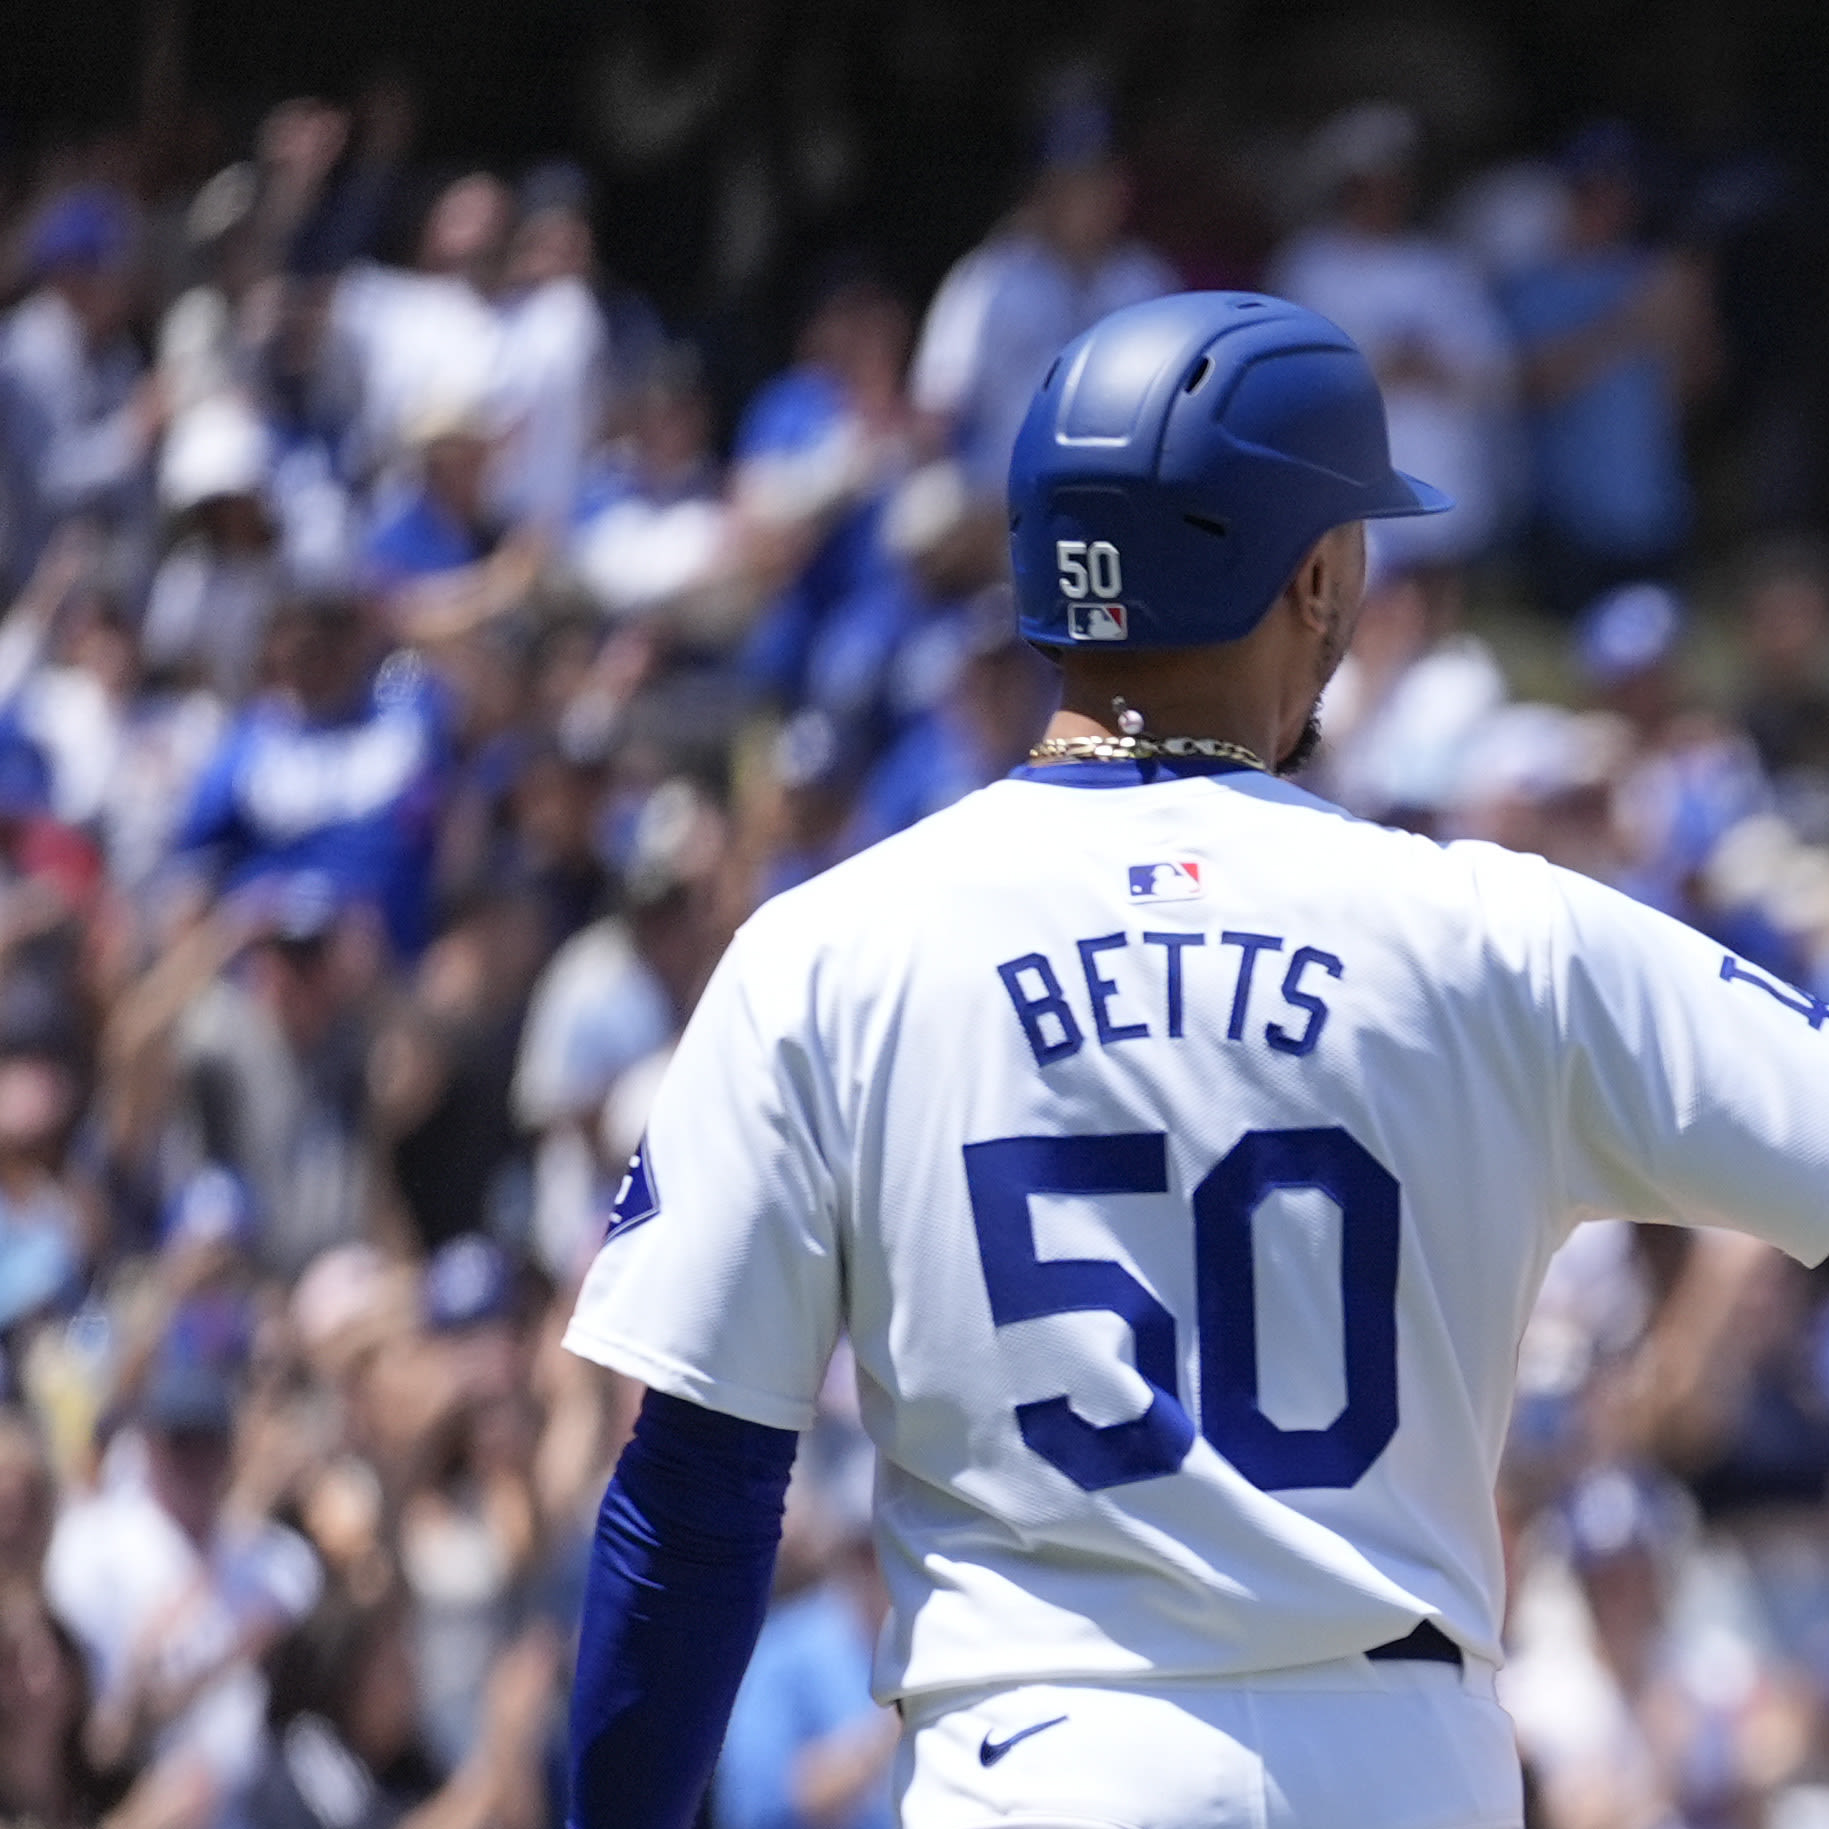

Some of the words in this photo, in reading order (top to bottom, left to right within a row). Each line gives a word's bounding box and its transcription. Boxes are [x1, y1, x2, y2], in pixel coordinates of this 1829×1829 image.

[1056, 540, 1122, 599] 50
[997, 931, 1344, 1067] BETTS
[962, 1125, 1401, 1492] 50
